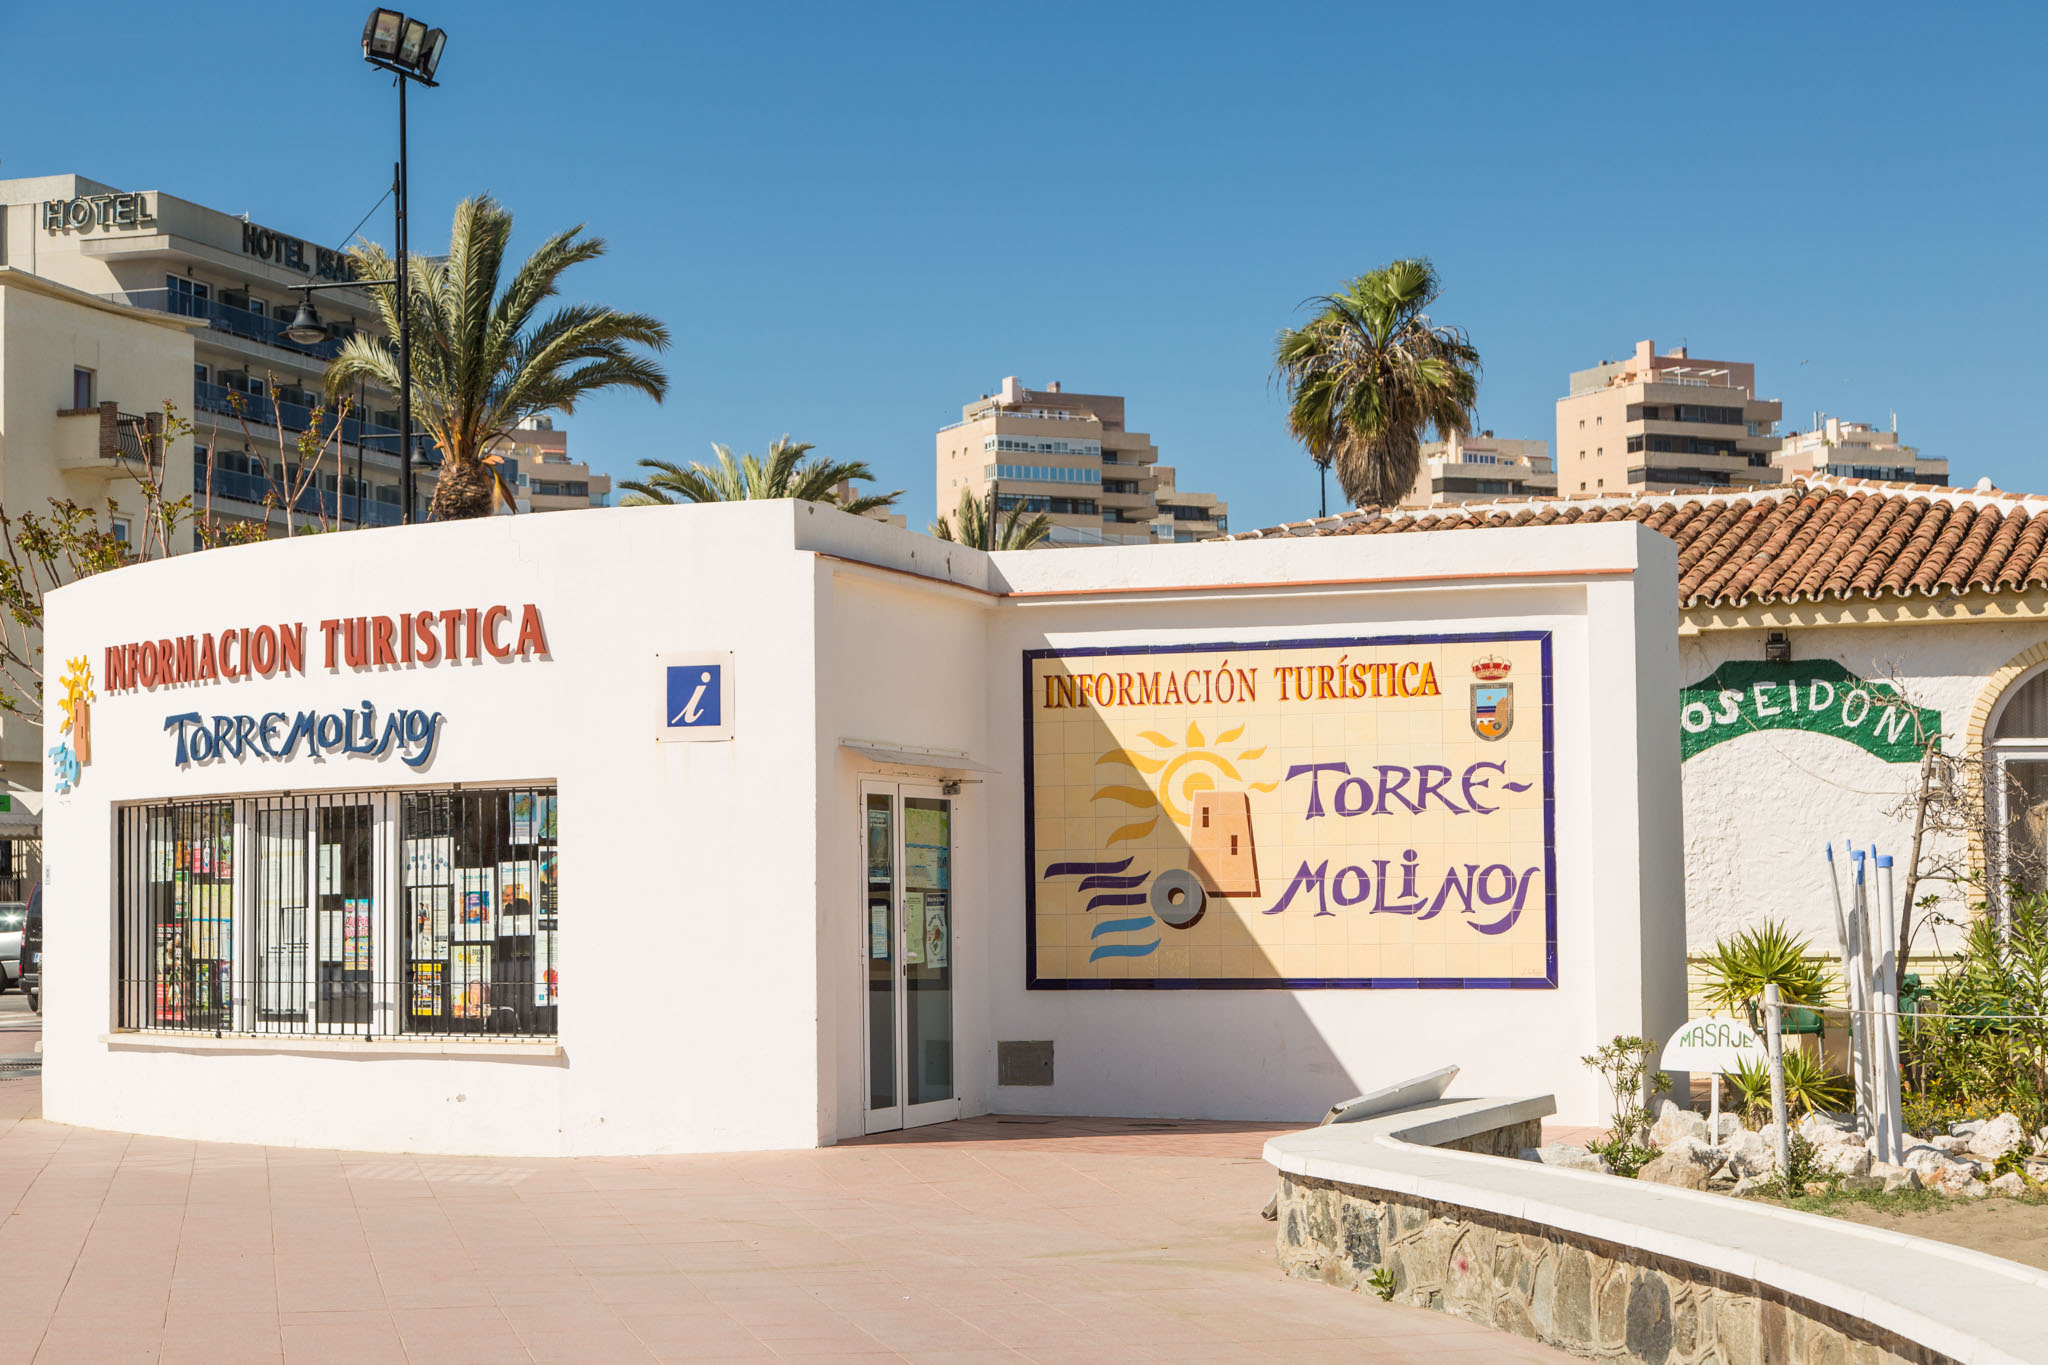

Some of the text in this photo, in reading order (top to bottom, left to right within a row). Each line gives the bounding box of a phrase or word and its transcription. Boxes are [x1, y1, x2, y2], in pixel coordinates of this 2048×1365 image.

[43, 193, 152, 230] HOTEL
[242, 223, 309, 272] HOTEL
[104, 604, 548, 692] INFORMACION TURISTICA
[1043, 655, 1442, 709] INFORMACIÓN TURÍSTICA
[1681, 679, 1910, 744] OSEIDON
[1680, 1023, 1753, 1048] MASAJE
